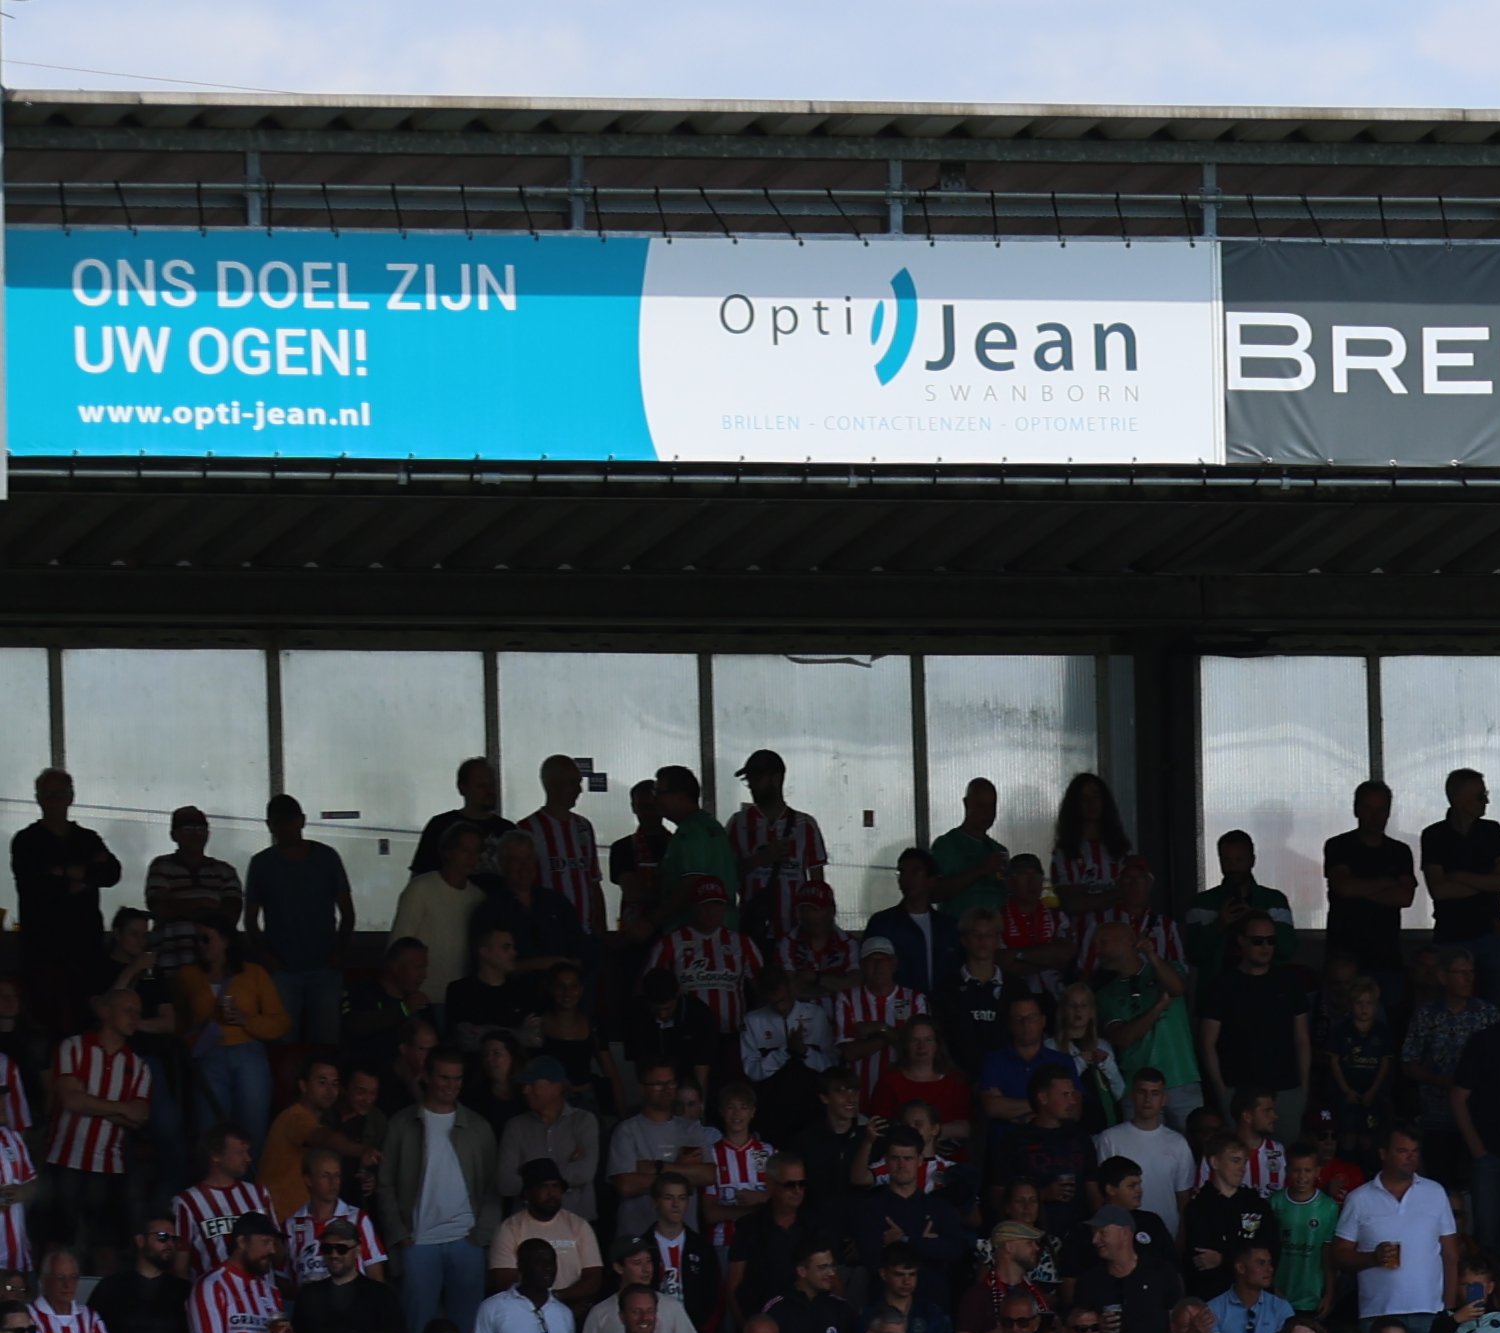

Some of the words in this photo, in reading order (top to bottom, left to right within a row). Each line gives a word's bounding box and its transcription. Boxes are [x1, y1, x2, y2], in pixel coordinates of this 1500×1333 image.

[71, 259, 195, 310] ONS
[216, 262, 368, 310] DOEL
[386, 264, 516, 311] ZIJN
[719, 293, 855, 345] Opti
[924, 305, 1140, 373] Jean
[73, 327, 172, 375] UW
[190, 326, 368, 377] OGEN!
[78, 401, 371, 432] www.opti-jean.nl
[925, 384, 1142, 402] SWANBORN
[722, 413, 802, 432] BRILLEN
[824, 413, 993, 432] CONTACTLENZEN
[1016, 413, 1140, 432] OPTOMETRIE
